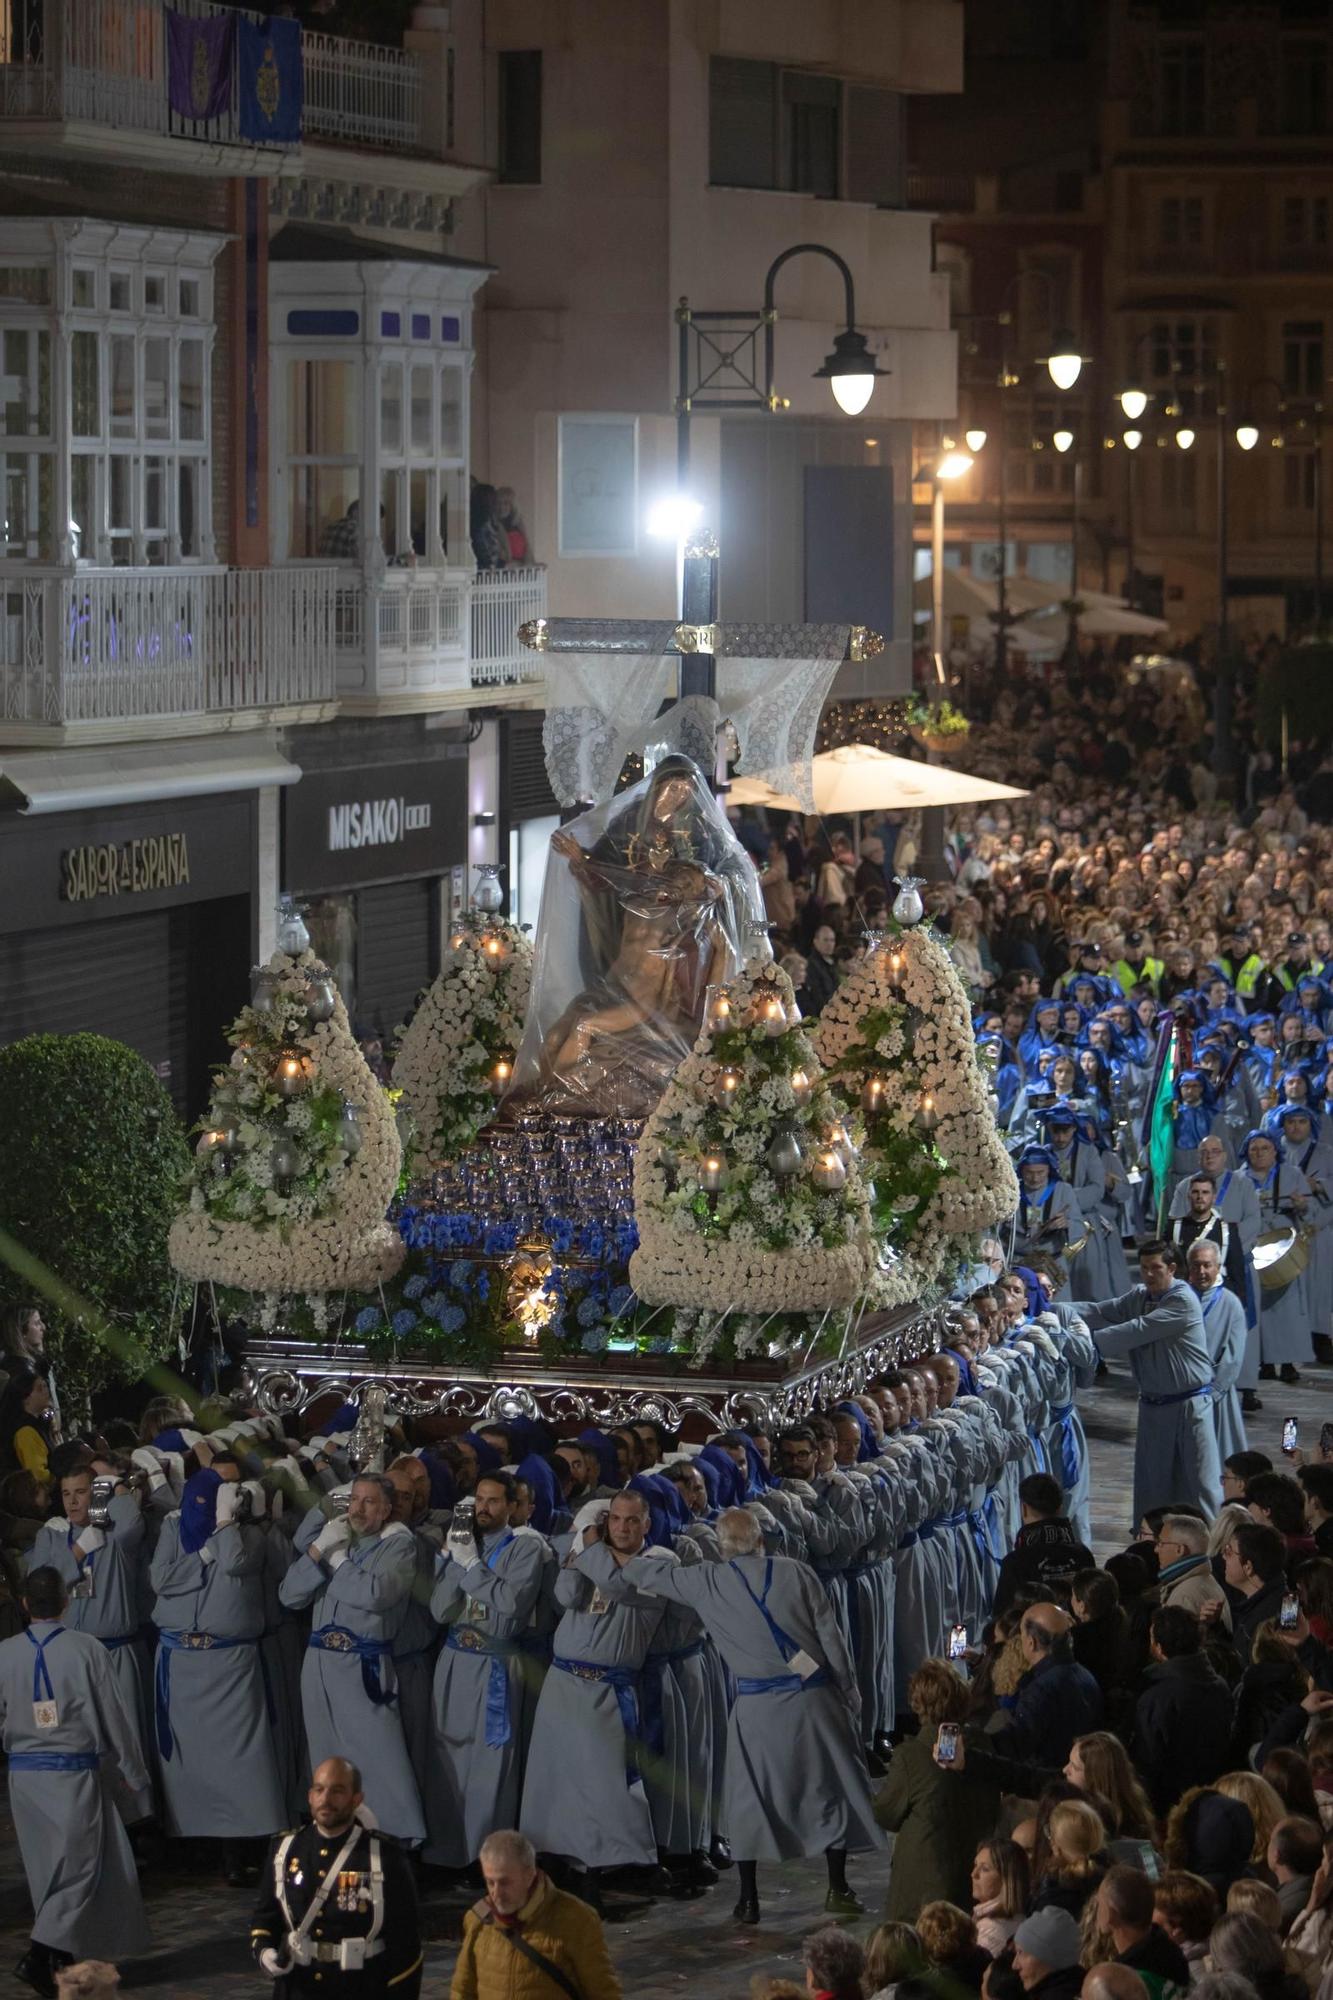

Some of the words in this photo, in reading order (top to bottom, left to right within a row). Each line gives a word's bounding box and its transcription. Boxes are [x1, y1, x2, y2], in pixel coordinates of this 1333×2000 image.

[328, 798, 399, 851] MISAKO
[67, 843, 119, 901] SABOR
[120, 847, 131, 886] A
[132, 833, 190, 892] ESPAÑA
